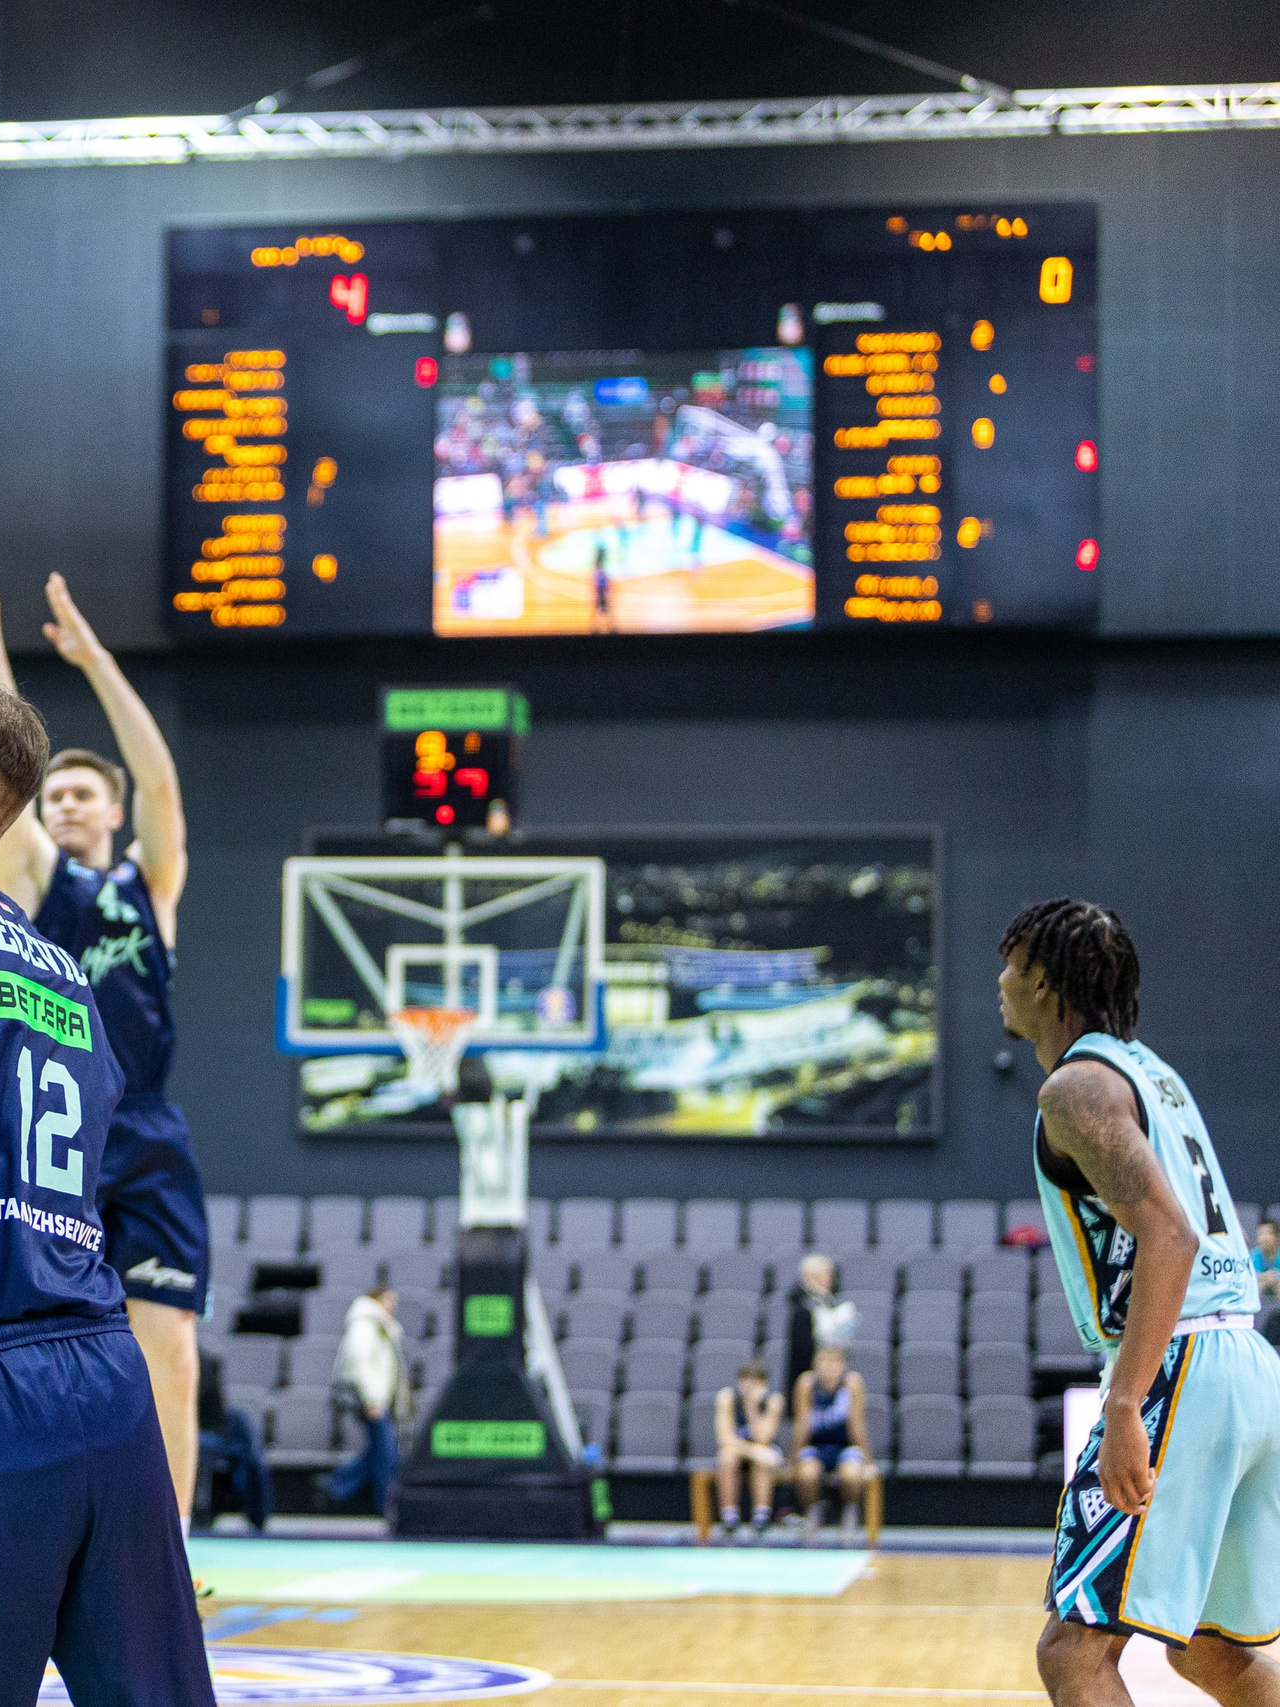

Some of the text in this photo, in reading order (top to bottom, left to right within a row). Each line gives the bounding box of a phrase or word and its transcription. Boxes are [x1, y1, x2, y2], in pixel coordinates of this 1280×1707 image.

[330, 273, 368, 324] 4
[17, 1046, 83, 1196] 12
[1183, 1134, 1228, 1236] 2
